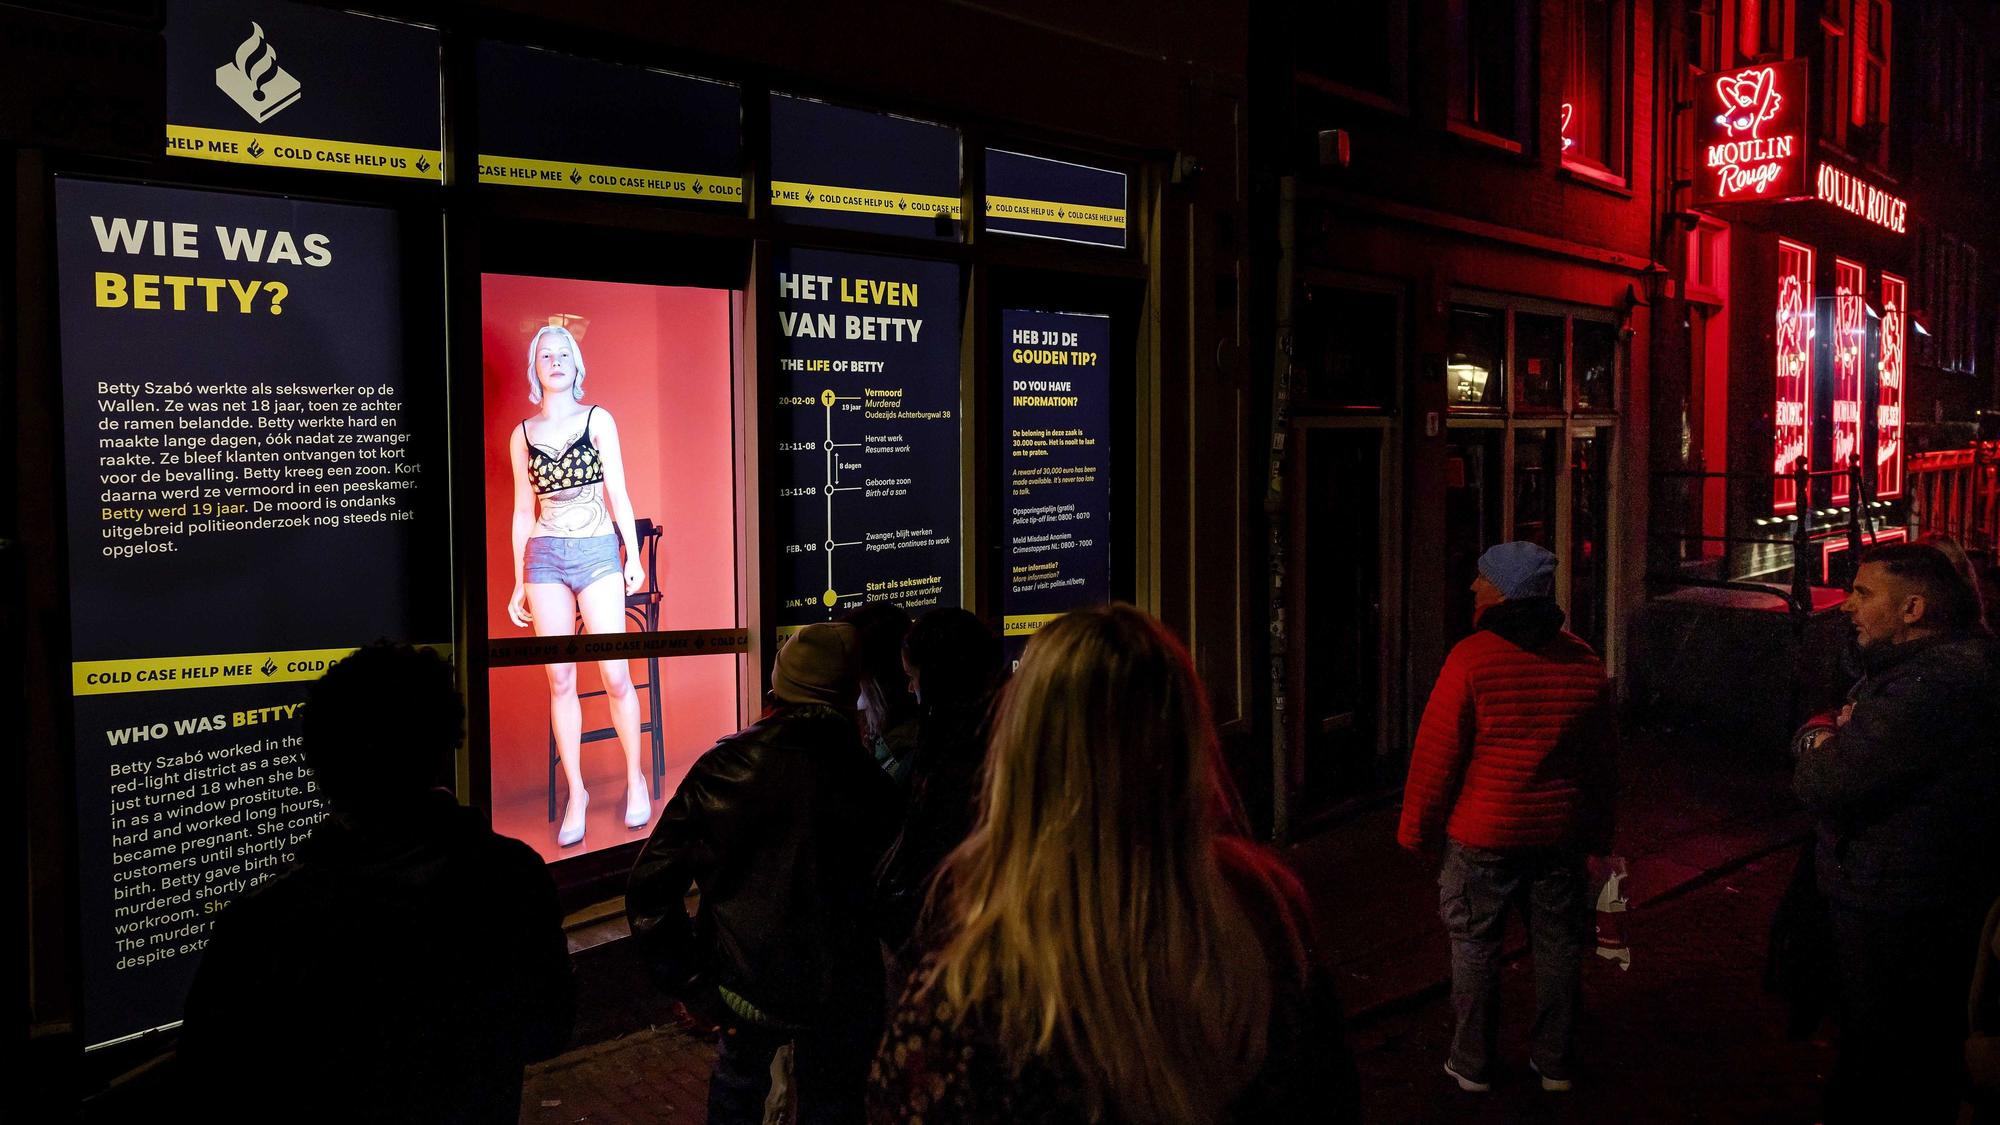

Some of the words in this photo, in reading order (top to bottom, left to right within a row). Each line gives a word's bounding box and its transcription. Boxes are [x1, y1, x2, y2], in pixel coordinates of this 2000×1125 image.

[166, 138, 204, 150] HELP
[208, 141, 238, 154] MEE
[1707, 135, 1793, 167] MOULIN
[274, 147, 312, 160] COLD
[316, 151, 351, 164] CASE
[355, 154, 387, 167] HELP
[390, 157, 406, 169] US
[479, 166, 506, 176] CASE
[510, 168, 537, 179] HELP
[540, 170, 562, 181] MEE
[1718, 162, 1782, 197] Rouge
[589, 174, 617, 185] COLD
[619, 177, 645, 188] CASE
[648, 179, 671, 190] HELP
[673, 181, 686, 191] US
[709, 185, 733, 195] COLD
[771, 190, 781, 198] LP
[783, 191, 799, 200] MEE
[819, 194, 841, 204] COLD
[842, 196, 862, 206] CASE
[864, 198, 883, 207] HELP
[884, 200, 894, 208] US
[911, 202, 930, 211] COLD
[932, 204, 949, 212] CASE
[996, 204, 1013, 212] COLD
[1014, 206, 1029, 214] CASE
[1031, 207, 1045, 215] HELP
[1068, 211, 1083, 219] COLD
[1084, 212, 1098, 221] CASE
[1099, 214, 1113, 222] HELP
[1867, 185, 1907, 234] ROUGE
[90, 216, 199, 258] WIE
[215, 226, 332, 267] WAS
[95, 272, 288, 315] BETTY?
[780, 272, 833, 301] HET
[841, 278, 918, 307] LEVEN
[779, 312, 836, 339] VAN
[845, 315, 923, 342] BETTY
[1013, 329, 1039, 345] HEB
[1042, 331, 1058, 346] JIJ
[1062, 332, 1078, 347] DE
[1013, 349, 1068, 365] GOUDEN
[1071, 352, 1097, 366] TIP?
[781, 359, 804, 371] THE
[807, 360, 830, 371] LIFE
[832, 360, 848, 372] OF
[851, 361, 884, 373] BETTY
[98, 382, 140, 397] Betty
[145, 381, 193, 394] Szabó
[196, 382, 247, 394] werkte
[251, 382, 272, 395] als
[276, 383, 355, 395] sekswerker
[358, 386, 375, 398] op
[378, 383, 394, 395] de
[865, 388, 902, 397] Vermoord
[1013, 380, 1027, 391] DO
[1028, 381, 1047, 391] YOU
[1048, 381, 1071, 392] HAVE
[98, 399, 160, 412] Wallen.
[164, 400, 184, 412] Ze
[188, 402, 218, 412] was
[223, 401, 246, 412] net
[251, 400, 270, 411] 18
[274, 399, 304, 414] jaar,
[308, 401, 338, 411] toen
[342, 402, 357, 411] ze
[361, 399, 402, 411] achter
[780, 397, 815, 405] 20-02-09
[850, 404, 862, 412] jaar
[865, 399, 901, 408] Murdered
[1013, 396, 1078, 407] INFORMATION?
[865, 410, 897, 420] Oudezijds
[897, 410, 941, 420] Achterburgwal
[942, 410, 951, 418] 38
[98, 417, 119, 430] de
[124, 420, 174, 430] ramen
[179, 416, 253, 429] belandde.
[258, 417, 295, 431] Betty
[298, 416, 344, 428] werkte
[348, 415, 377, 427] hard
[381, 418, 396, 427] en
[100, 434, 159, 448] maakte
[164, 434, 206, 449] lange
[210, 433, 261, 449] dagen,
[266, 432, 292, 445] óók
[296, 432, 335, 444] nadat
[338, 434, 353, 443] ze
[356, 434, 411, 445] zwanger
[865, 435, 887, 443] Hervat
[887, 434, 903, 442] werk
[780, 442, 816, 450] 21-11-08
[865, 445, 894, 453] Resumes
[895, 444, 910, 453] work
[844, 462, 862, 470] dagen
[865, 478, 895, 487] Geboorte
[781, 487, 816, 496] 13-11-08
[865, 489, 881, 498] Birth
[882, 488, 889, 496] of
[102, 508, 144, 522] Betty
[148, 504, 186, 518] werd
[192, 503, 212, 516] 19
[216, 502, 248, 518] jaar.
[253, 501, 273, 512] De
[277, 497, 322, 511] moord
[326, 497, 337, 508] is
[340, 494, 396, 508] ondanks
[1012, 517, 1029, 525] Police
[1029, 515, 1046, 524] tip-off
[1058, 513, 1072, 521] 0800
[1076, 512, 1090, 520] 6070
[786, 544, 802, 553] FEB.
[866, 581, 886, 591] Start
[887, 580, 899, 589] als
[899, 575, 941, 587] sekswerker
[1011, 622, 1026, 630] CASE
[287, 660, 324, 672] COLD
[87, 672, 132, 685] COLD
[136, 669, 176, 682] CASE
[182, 667, 219, 679] HELP
[223, 664, 252, 676] MEE
[106, 723, 168, 746] WHO
[174, 714, 226, 736] WAS
[111, 761, 153, 778] Betty
[156, 750, 203, 771] Szabó
[207, 740, 261, 760] worked
[266, 739, 278, 750] in
[282, 735, 303, 748] the
[111, 772, 180, 794] red-light
[183, 763, 236, 781] district
[240, 761, 257, 772] as
[260, 759, 269, 768] a
[273, 754, 297, 766] sex
[110, 796, 141, 816] just
[144, 785, 195, 808] turned
[201, 782, 221, 796] 18
[225, 776, 264, 791] when
[268, 770, 293, 783] she
